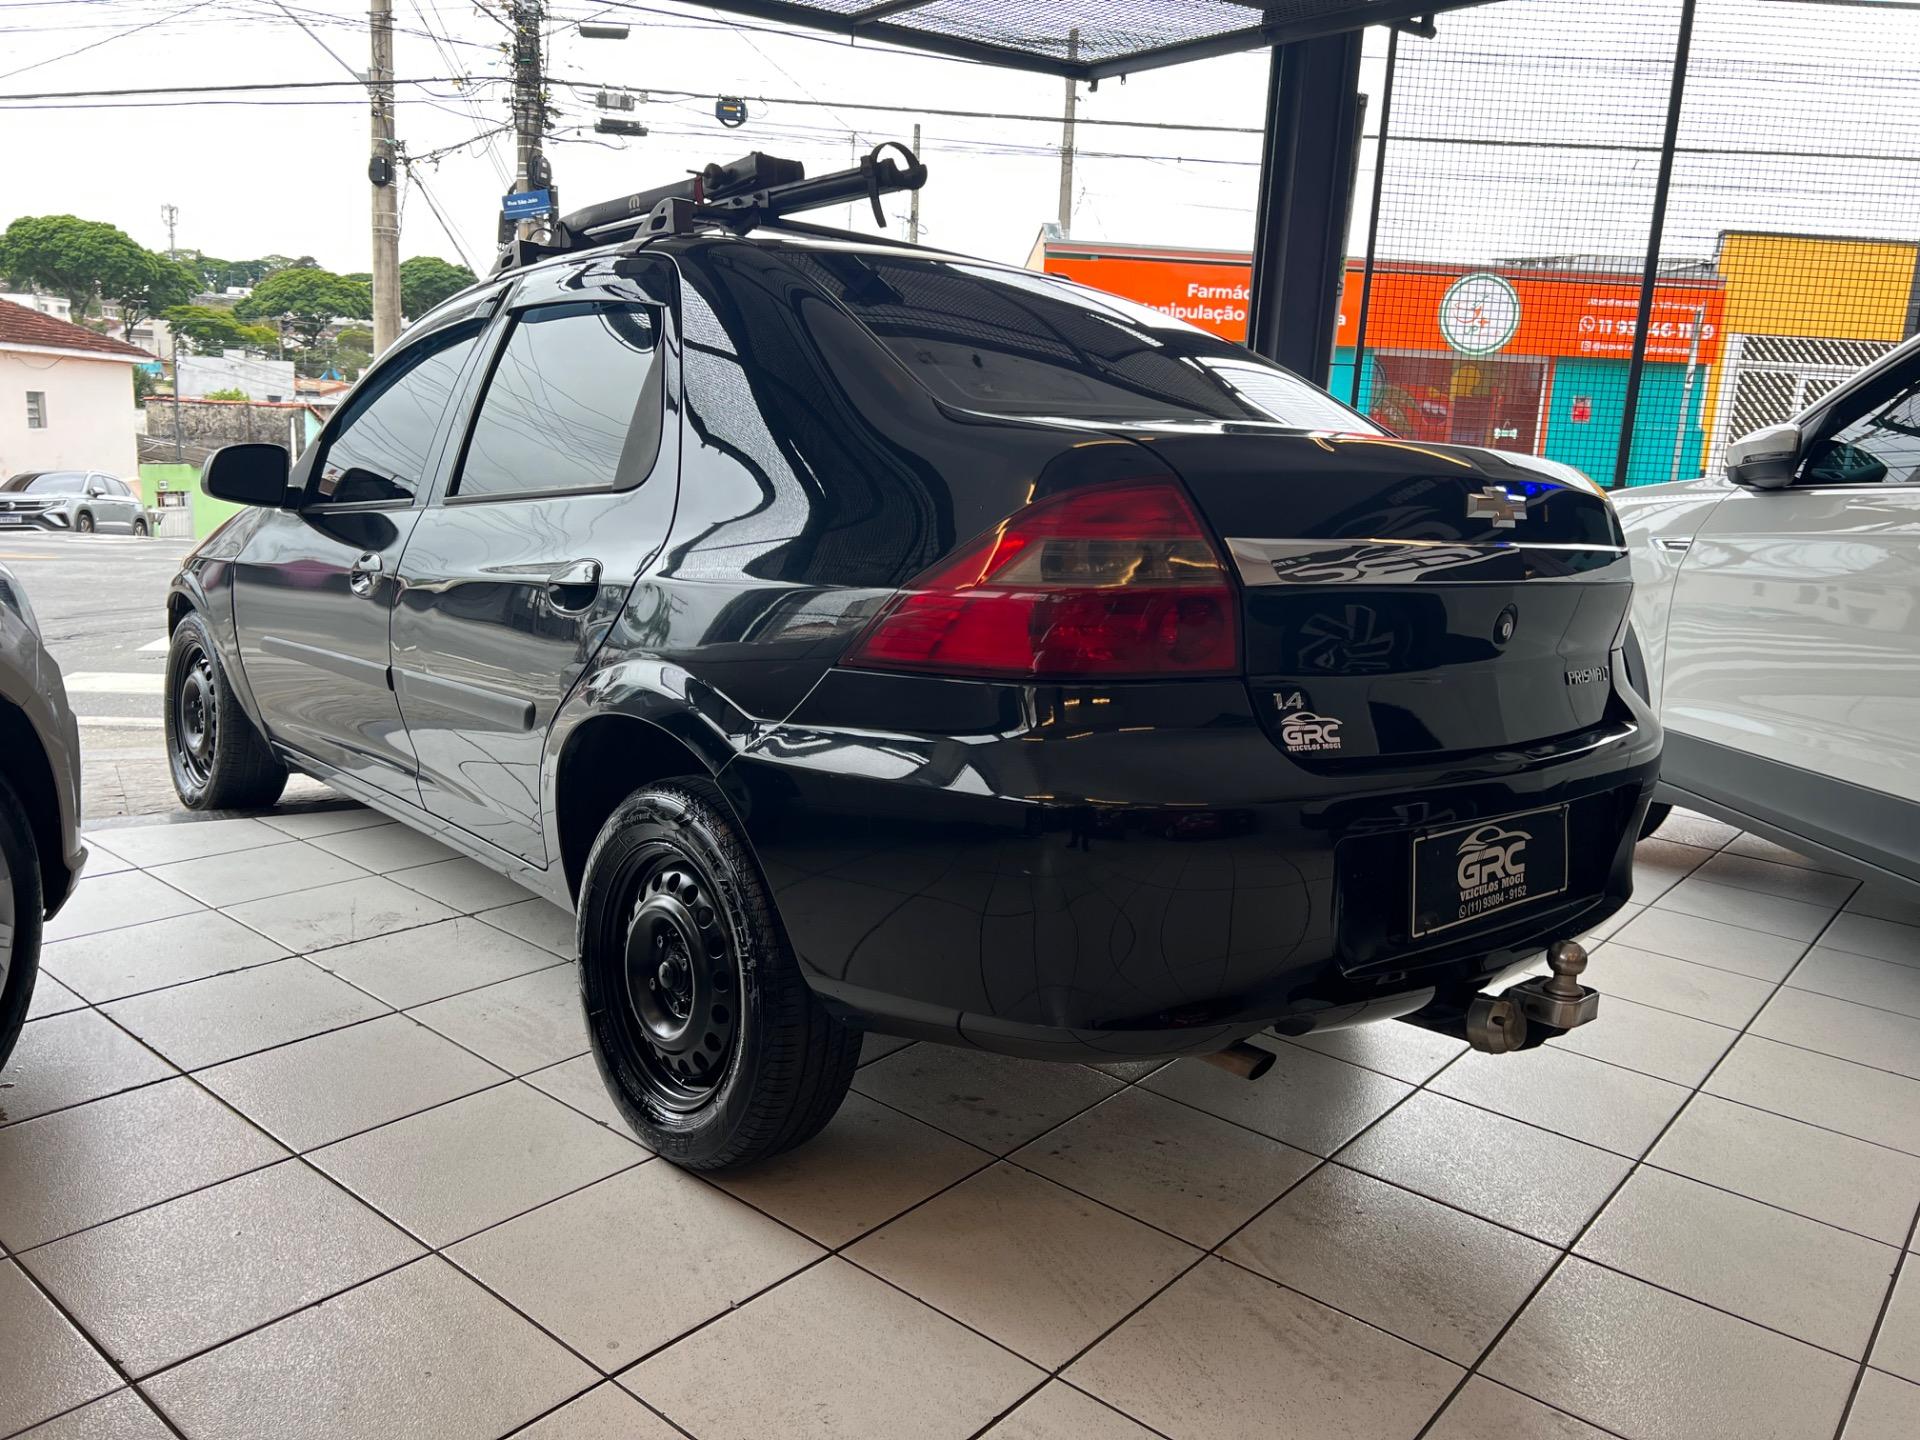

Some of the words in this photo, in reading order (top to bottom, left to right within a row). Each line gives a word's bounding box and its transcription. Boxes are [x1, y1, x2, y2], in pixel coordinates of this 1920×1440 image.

[1187, 283, 1250, 300] Farmác
[1143, 302, 1246, 325] nipulação
[1282, 724, 1340, 745] GRC
[1457, 840, 1526, 890] GRC
[1460, 880, 1499, 902] VEICULOS
[1501, 873, 1524, 889] MOGI
